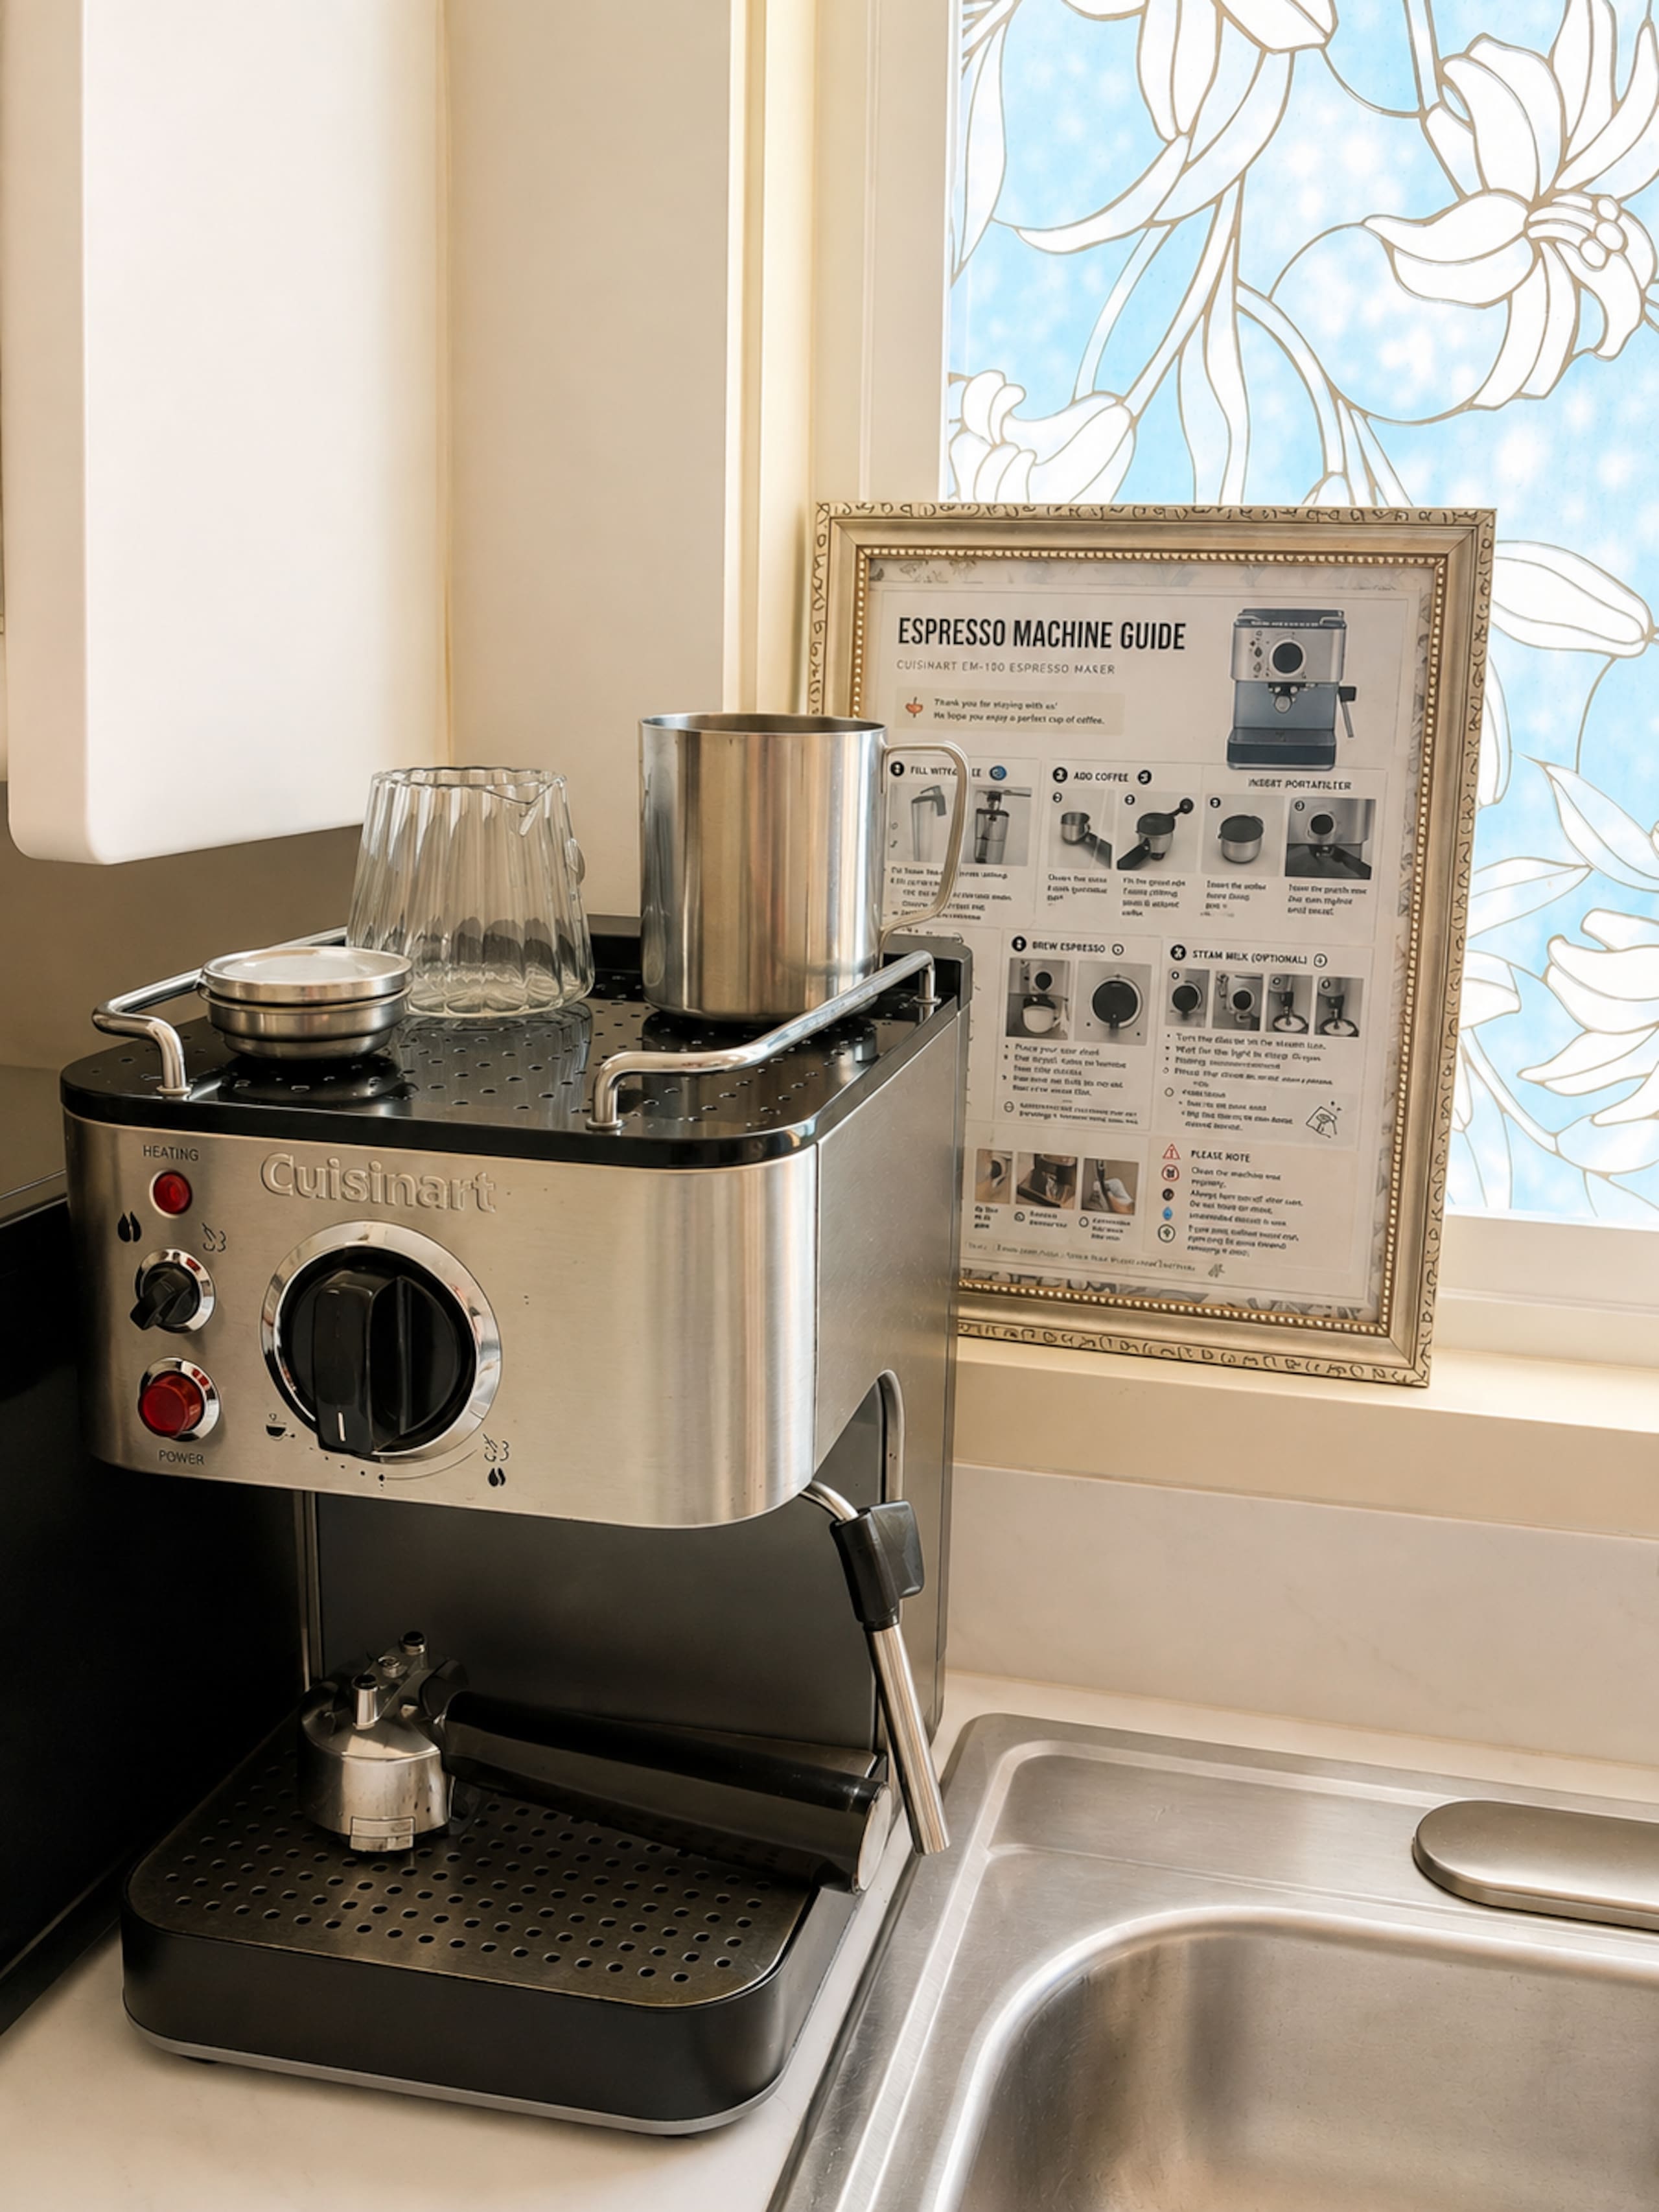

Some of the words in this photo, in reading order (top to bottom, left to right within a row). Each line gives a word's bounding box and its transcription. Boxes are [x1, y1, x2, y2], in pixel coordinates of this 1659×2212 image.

[898, 616, 1005, 647] ESPRESSO
[1014, 620, 1113, 648] MACHINE
[1120, 622, 1186, 650] GUIDE
[896, 659, 957, 671] CUISINART
[1010, 662, 1069, 674] ESPRESSO
[1095, 772, 1129, 782] COFFEE
[1060, 942, 1106, 953] ESPRESSO
[1192, 950, 1223, 959] STEAM
[143, 1145, 199, 1162] HEATING
[1191, 1150, 1222, 1160] PLEASE
[260, 1152, 496, 1213] Cuisinart
[158, 1450, 205, 1466] POWER
